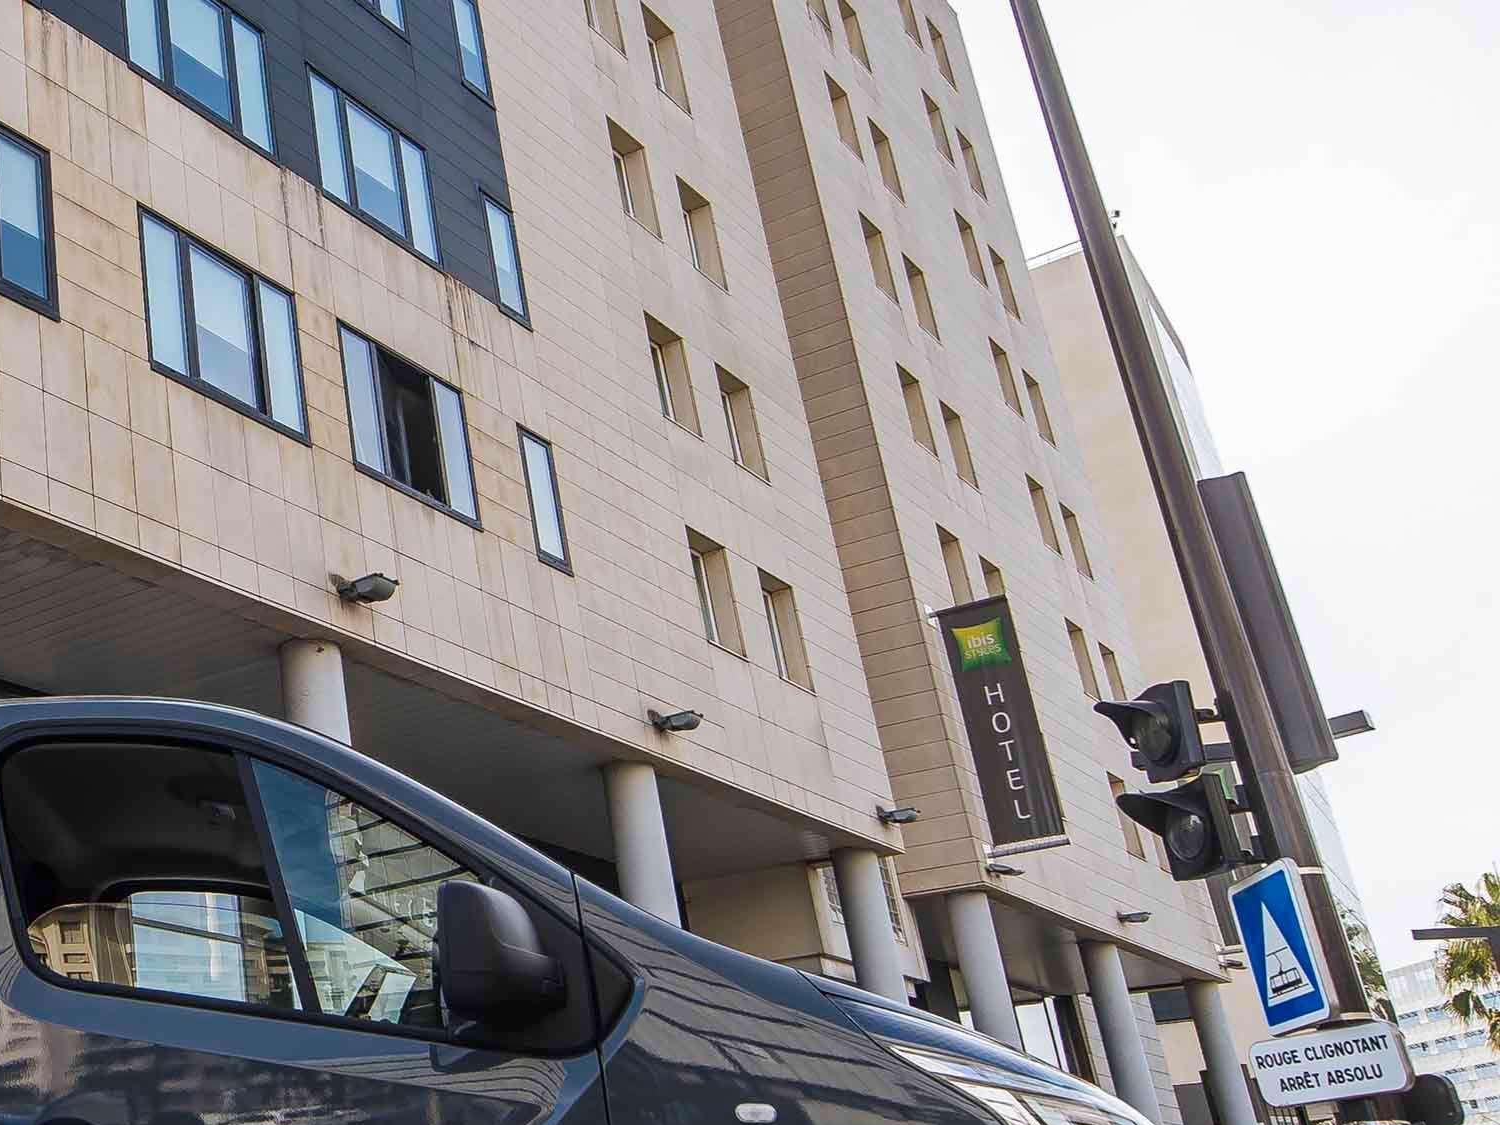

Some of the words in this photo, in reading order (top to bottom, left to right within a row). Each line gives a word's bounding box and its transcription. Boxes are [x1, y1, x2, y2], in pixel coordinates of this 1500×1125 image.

[967, 631, 996, 650] ibis
[984, 683, 1032, 820] HOTEL
[1255, 1049, 1302, 1070] ROUGE
[1304, 1034, 1389, 1062] CLIGNOTANT
[1279, 1071, 1321, 1093] ARRÊT
[1327, 1063, 1383, 1087] ABSOLU
